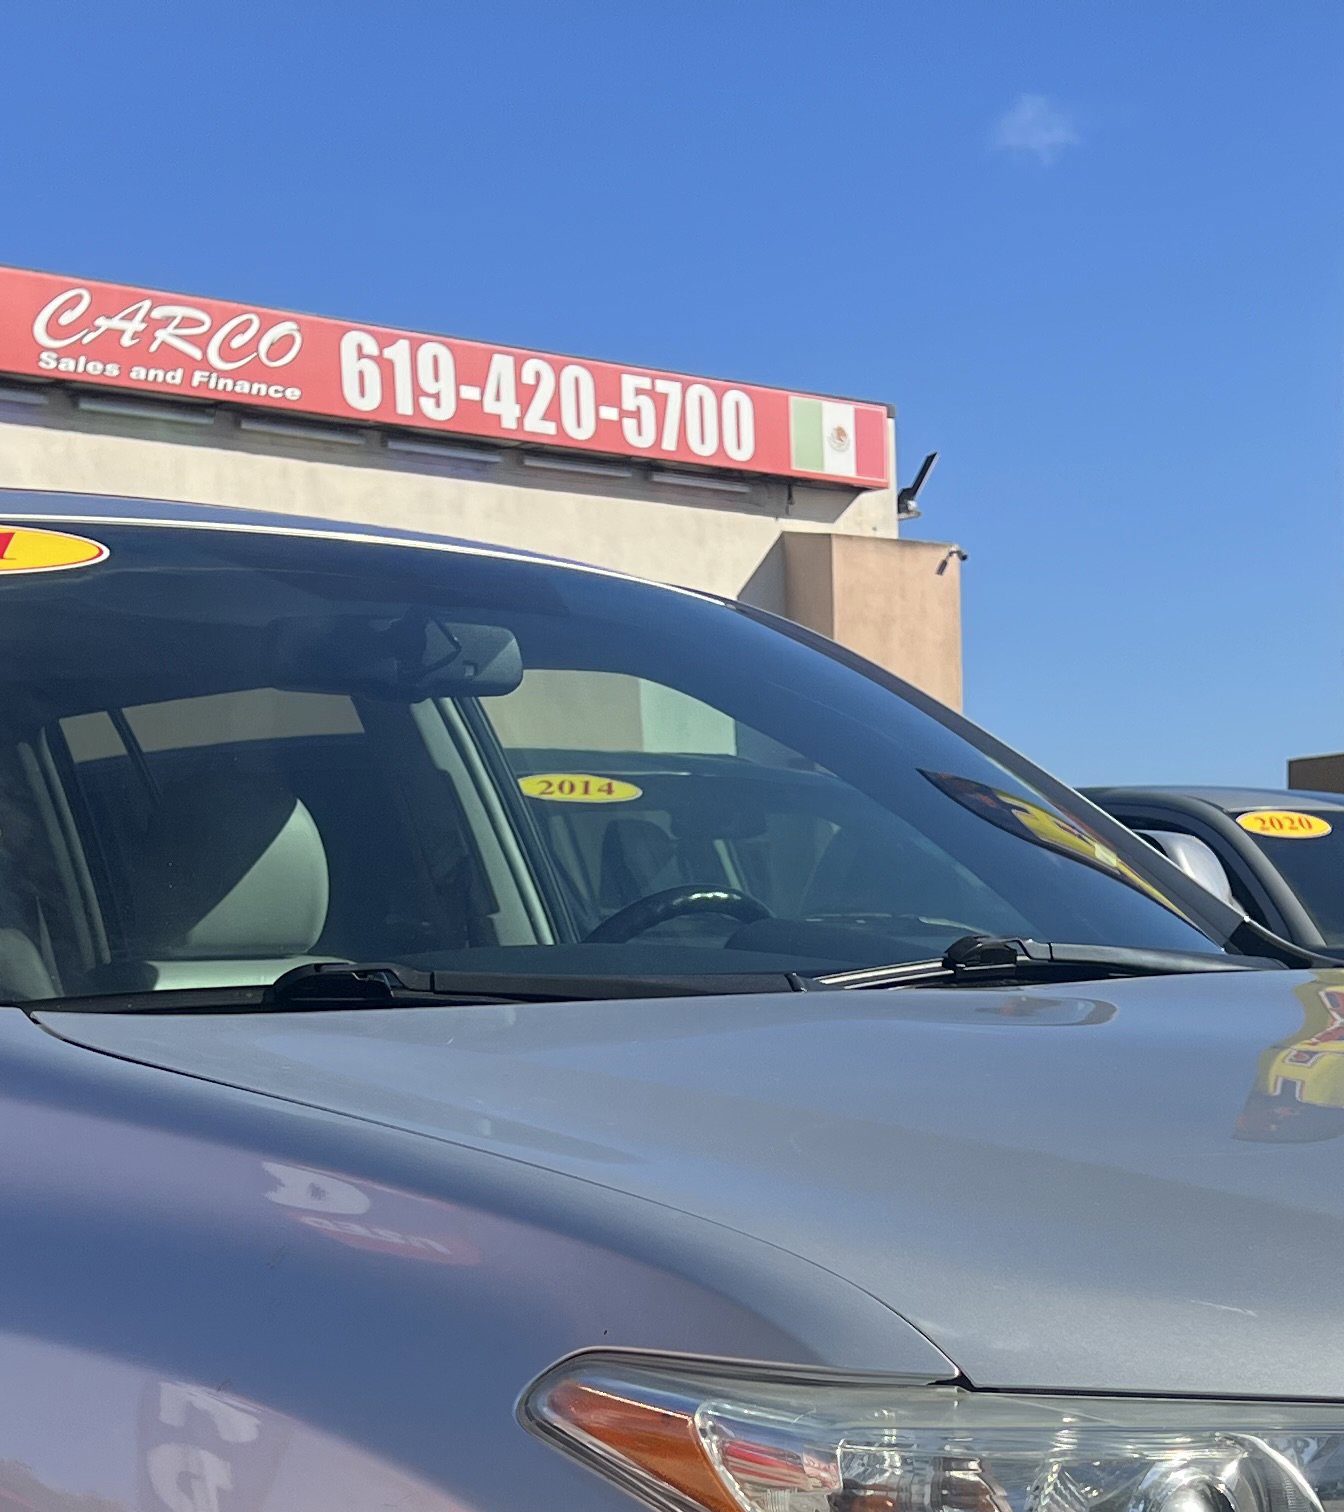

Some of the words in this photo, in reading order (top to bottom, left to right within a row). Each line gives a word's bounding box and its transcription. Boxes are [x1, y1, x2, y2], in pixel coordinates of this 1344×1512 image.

[32, 287, 303, 371] CARCO
[38, 350, 121, 377] Sales
[129, 364, 185, 386] and
[191, 370, 303, 401] Finance
[339, 329, 755, 463] 619-420-5700
[537, 779, 616, 796] 2014
[1254, 815, 1314, 832] 2020
